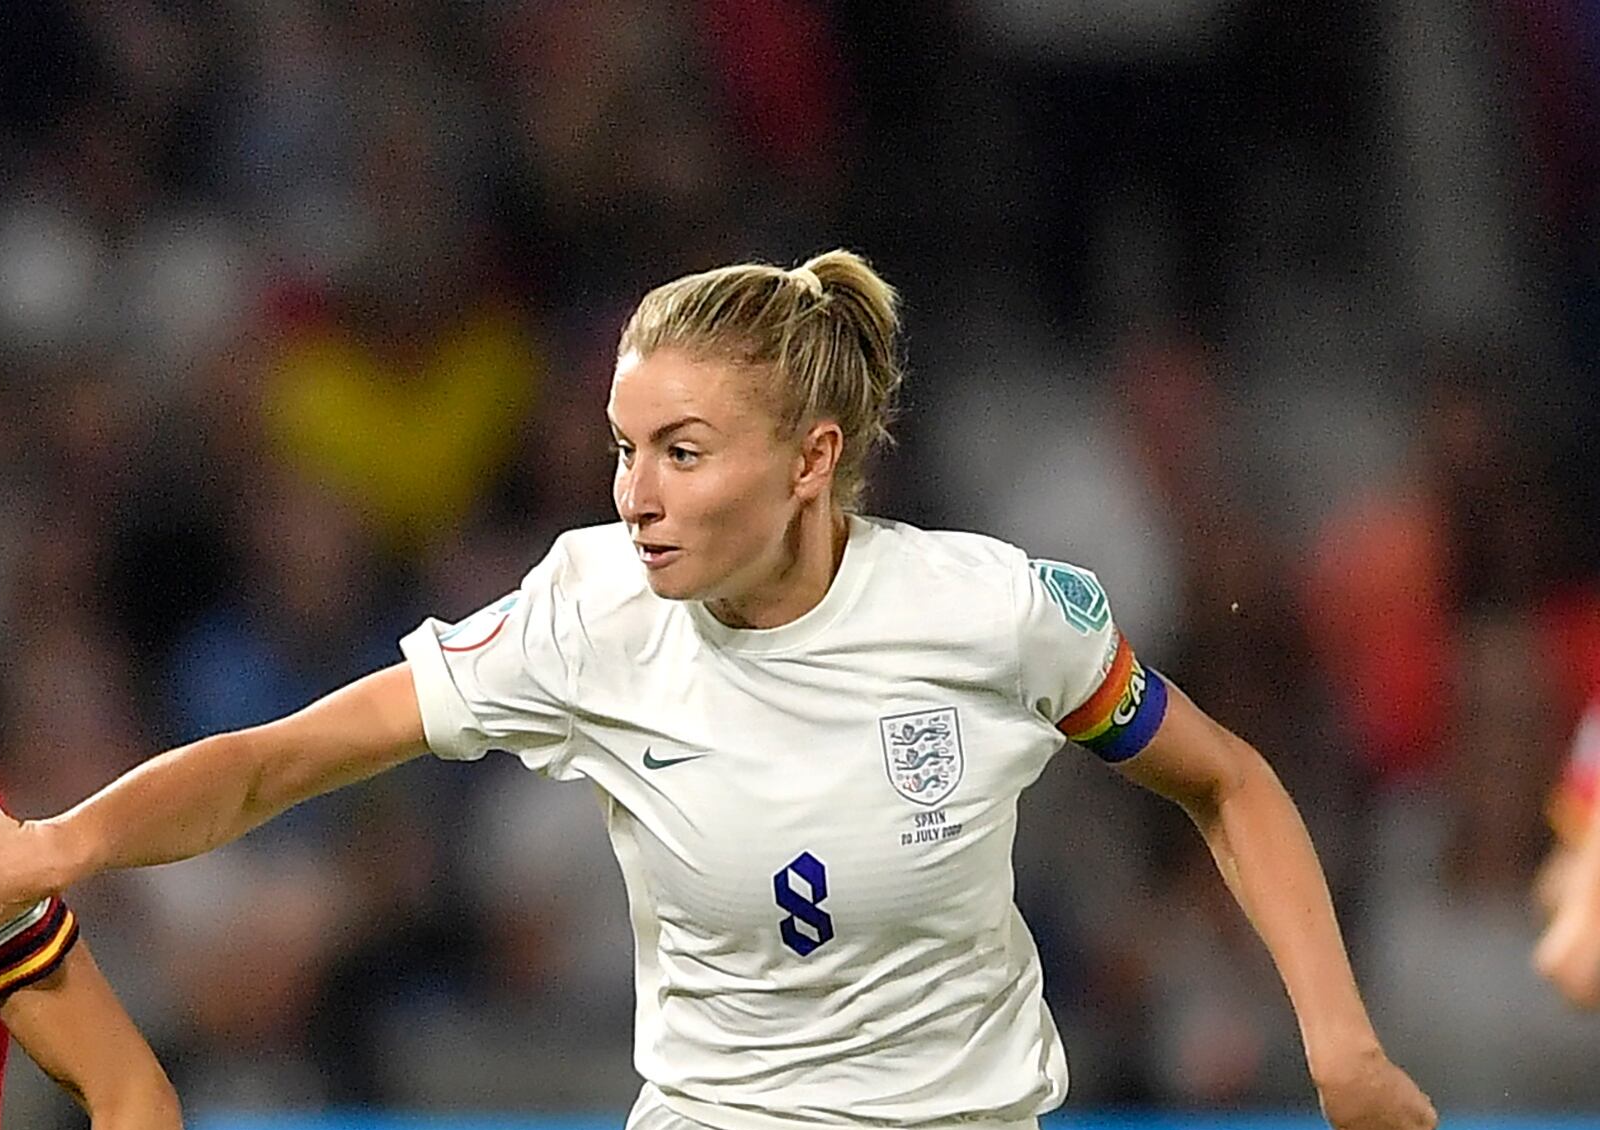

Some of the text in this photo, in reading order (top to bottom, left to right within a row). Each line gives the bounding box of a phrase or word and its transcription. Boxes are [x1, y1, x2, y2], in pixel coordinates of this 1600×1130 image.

[914, 811, 946, 828] SPAIN
[914, 827, 940, 843] JULY
[773, 851, 834, 957] 8
